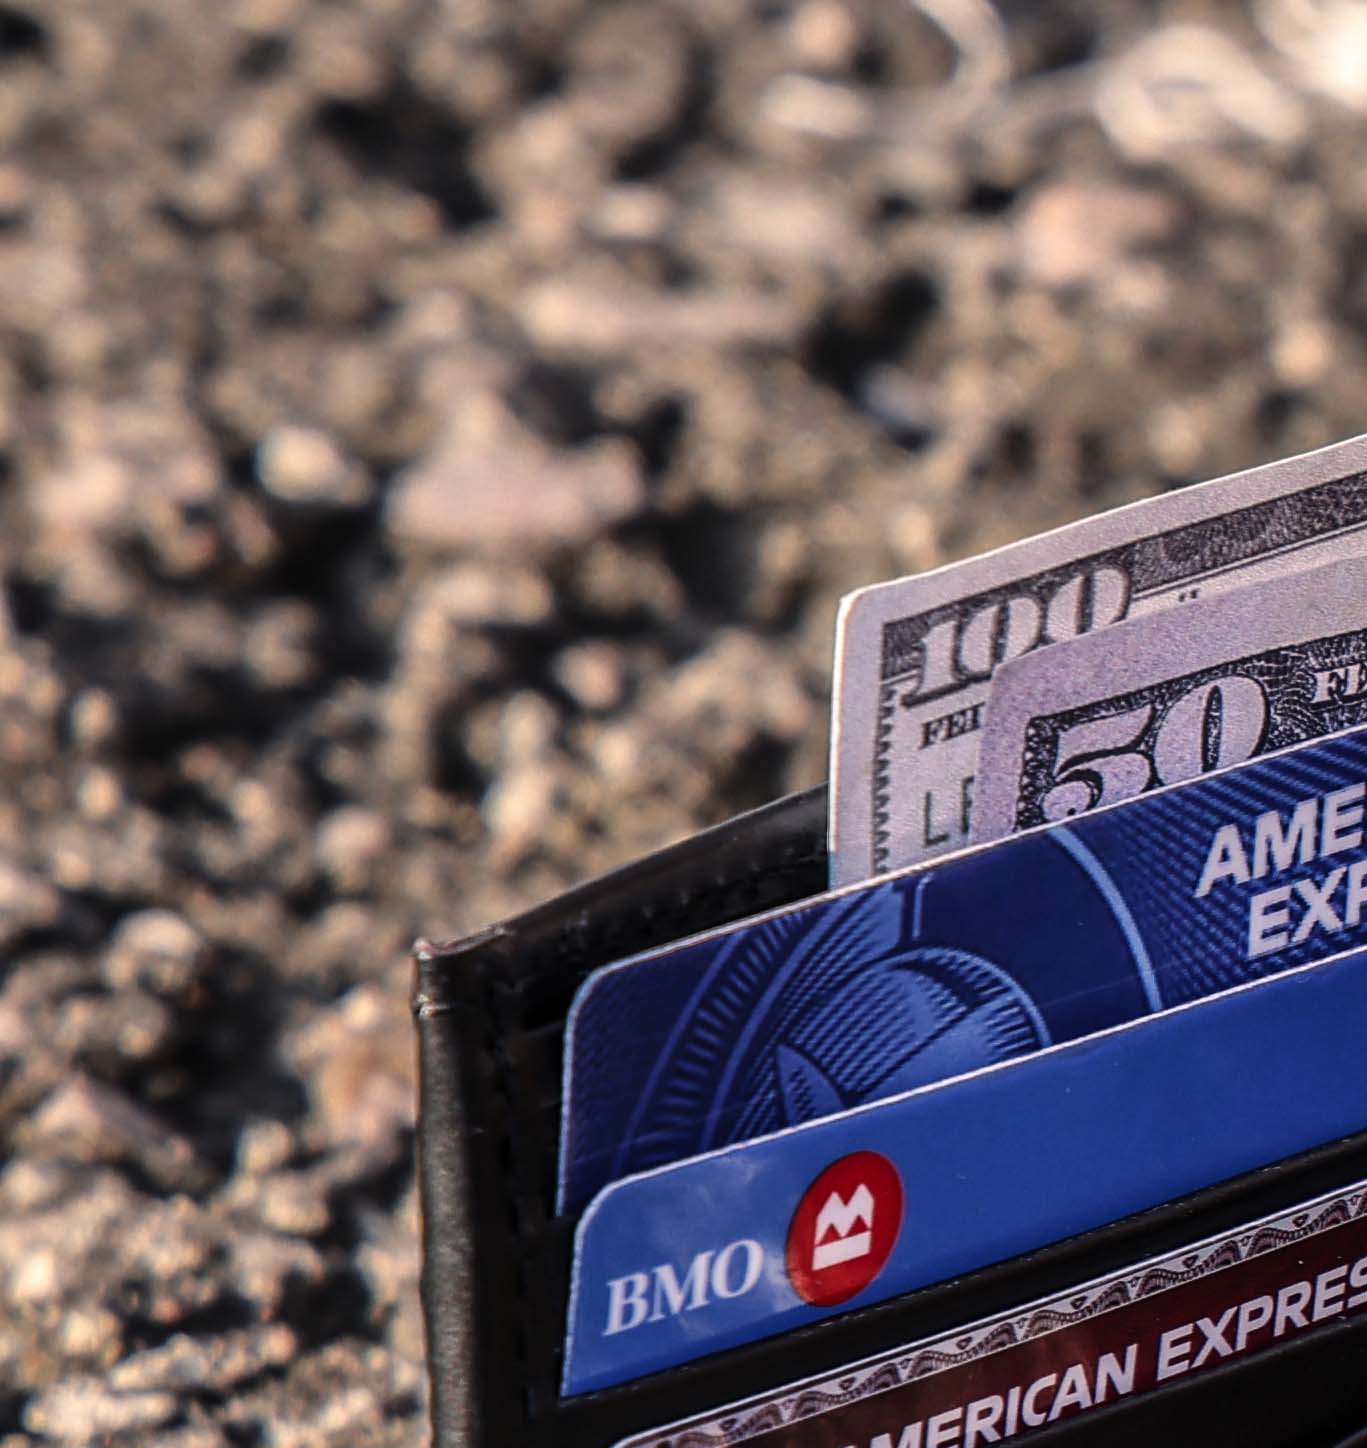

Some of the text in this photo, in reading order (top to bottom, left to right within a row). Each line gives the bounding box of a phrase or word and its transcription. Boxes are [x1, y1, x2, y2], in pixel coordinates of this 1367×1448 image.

[900, 567, 1132, 707] 100
[1040, 674, 1268, 826] 50
[603, 1239, 764, 1337] BMO
